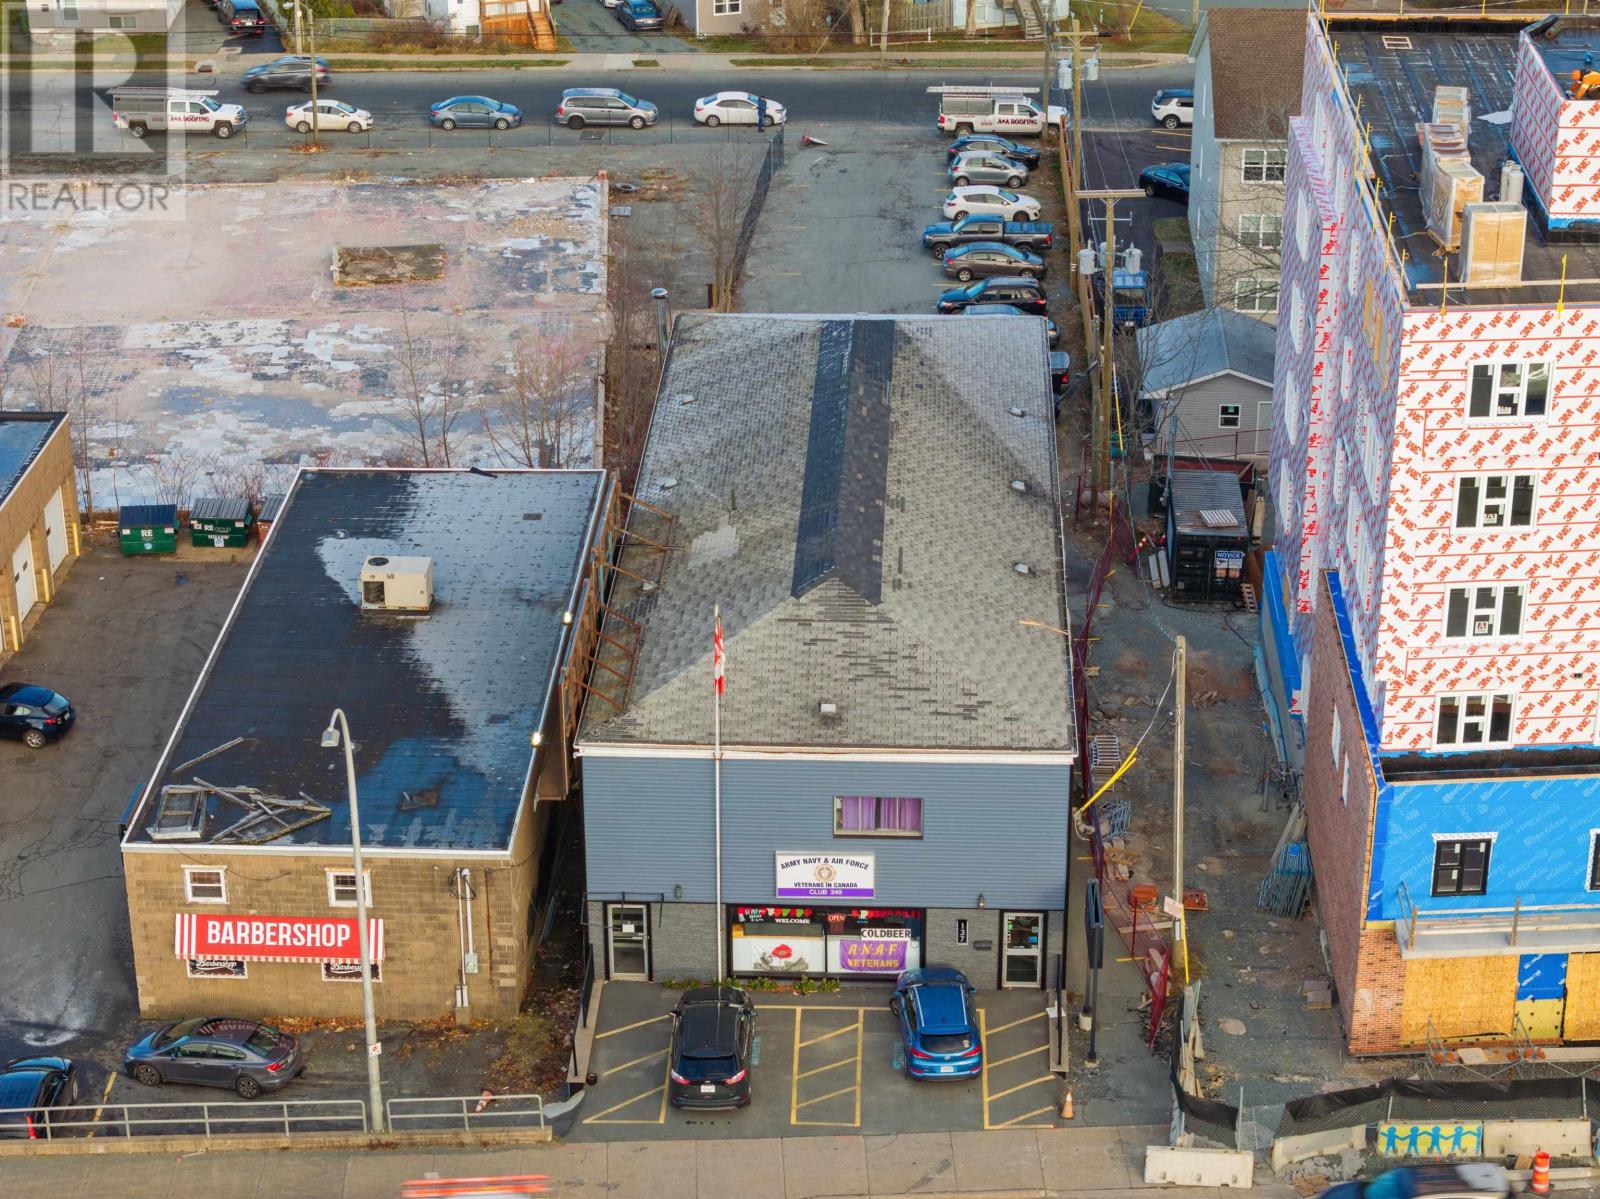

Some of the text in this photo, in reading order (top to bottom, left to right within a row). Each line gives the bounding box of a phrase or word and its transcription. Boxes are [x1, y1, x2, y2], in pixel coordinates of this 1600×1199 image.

[141, 529, 153, 537] RE
[780, 859, 801, 870] ARMY
[803, 857, 821, 865] NAVY
[845, 859, 870, 870] FORCE
[207, 920, 350, 947] BARBERSHOP
[847, 958, 899, 968] VETERANS
